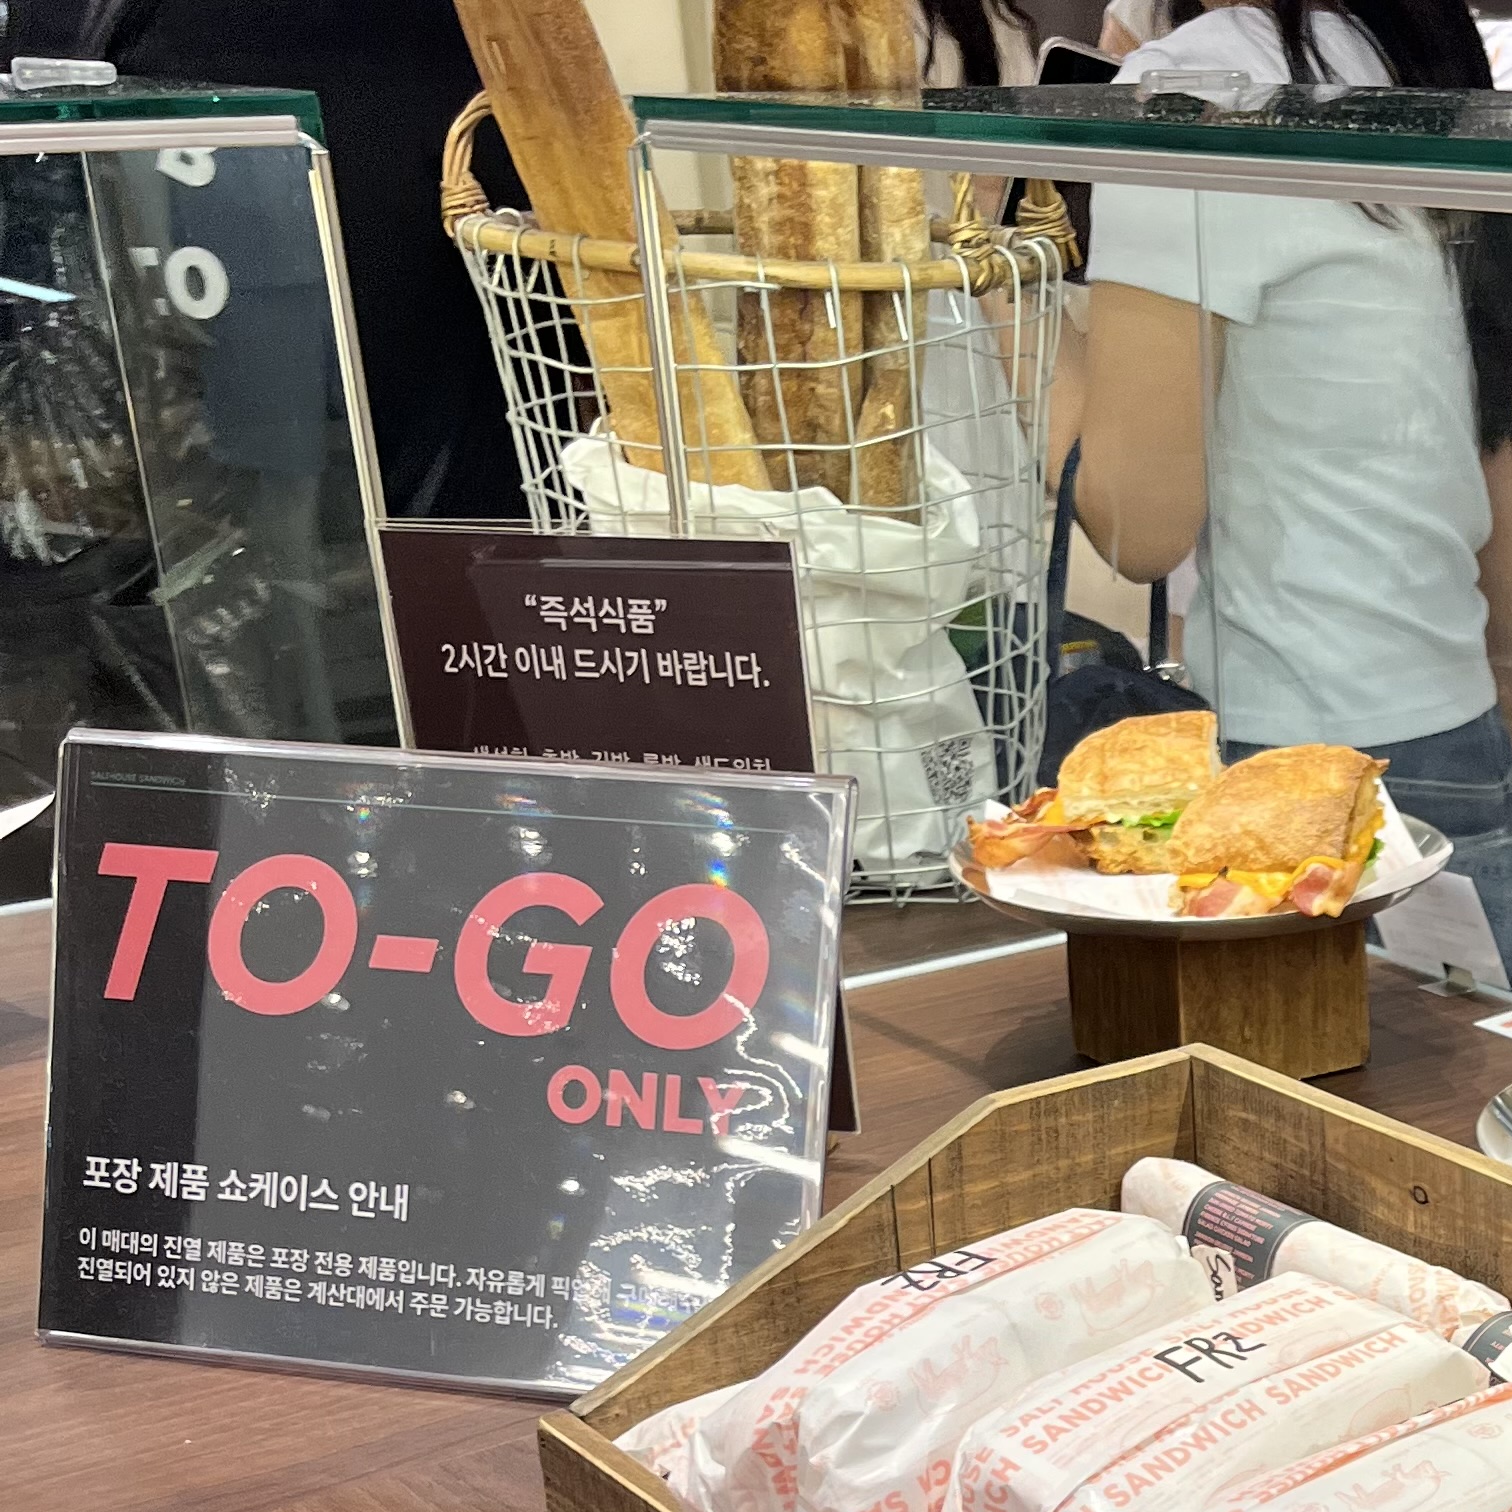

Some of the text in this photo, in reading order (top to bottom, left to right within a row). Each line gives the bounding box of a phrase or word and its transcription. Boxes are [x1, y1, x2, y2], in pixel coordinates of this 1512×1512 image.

[442, 643, 770, 688] 2시간 이내 드시기 바랍니다.
[96, 842, 771, 1052] TO-GO
[547, 1066, 747, 1137] ONLY
[83, 1155, 409, 1221] 포장 제품 쇼케이스 안내
[77, 1256, 559, 1329] 진열되어 있지 않은 제품은 계산대에서 주문 가능합니다.
[79, 1227, 545, 1297] 이 매대의 진열 제품은 포장 전용 제품입니다. 자유롭게
[1104, 1331, 1407, 1509] SANDWICH SANDWICH
